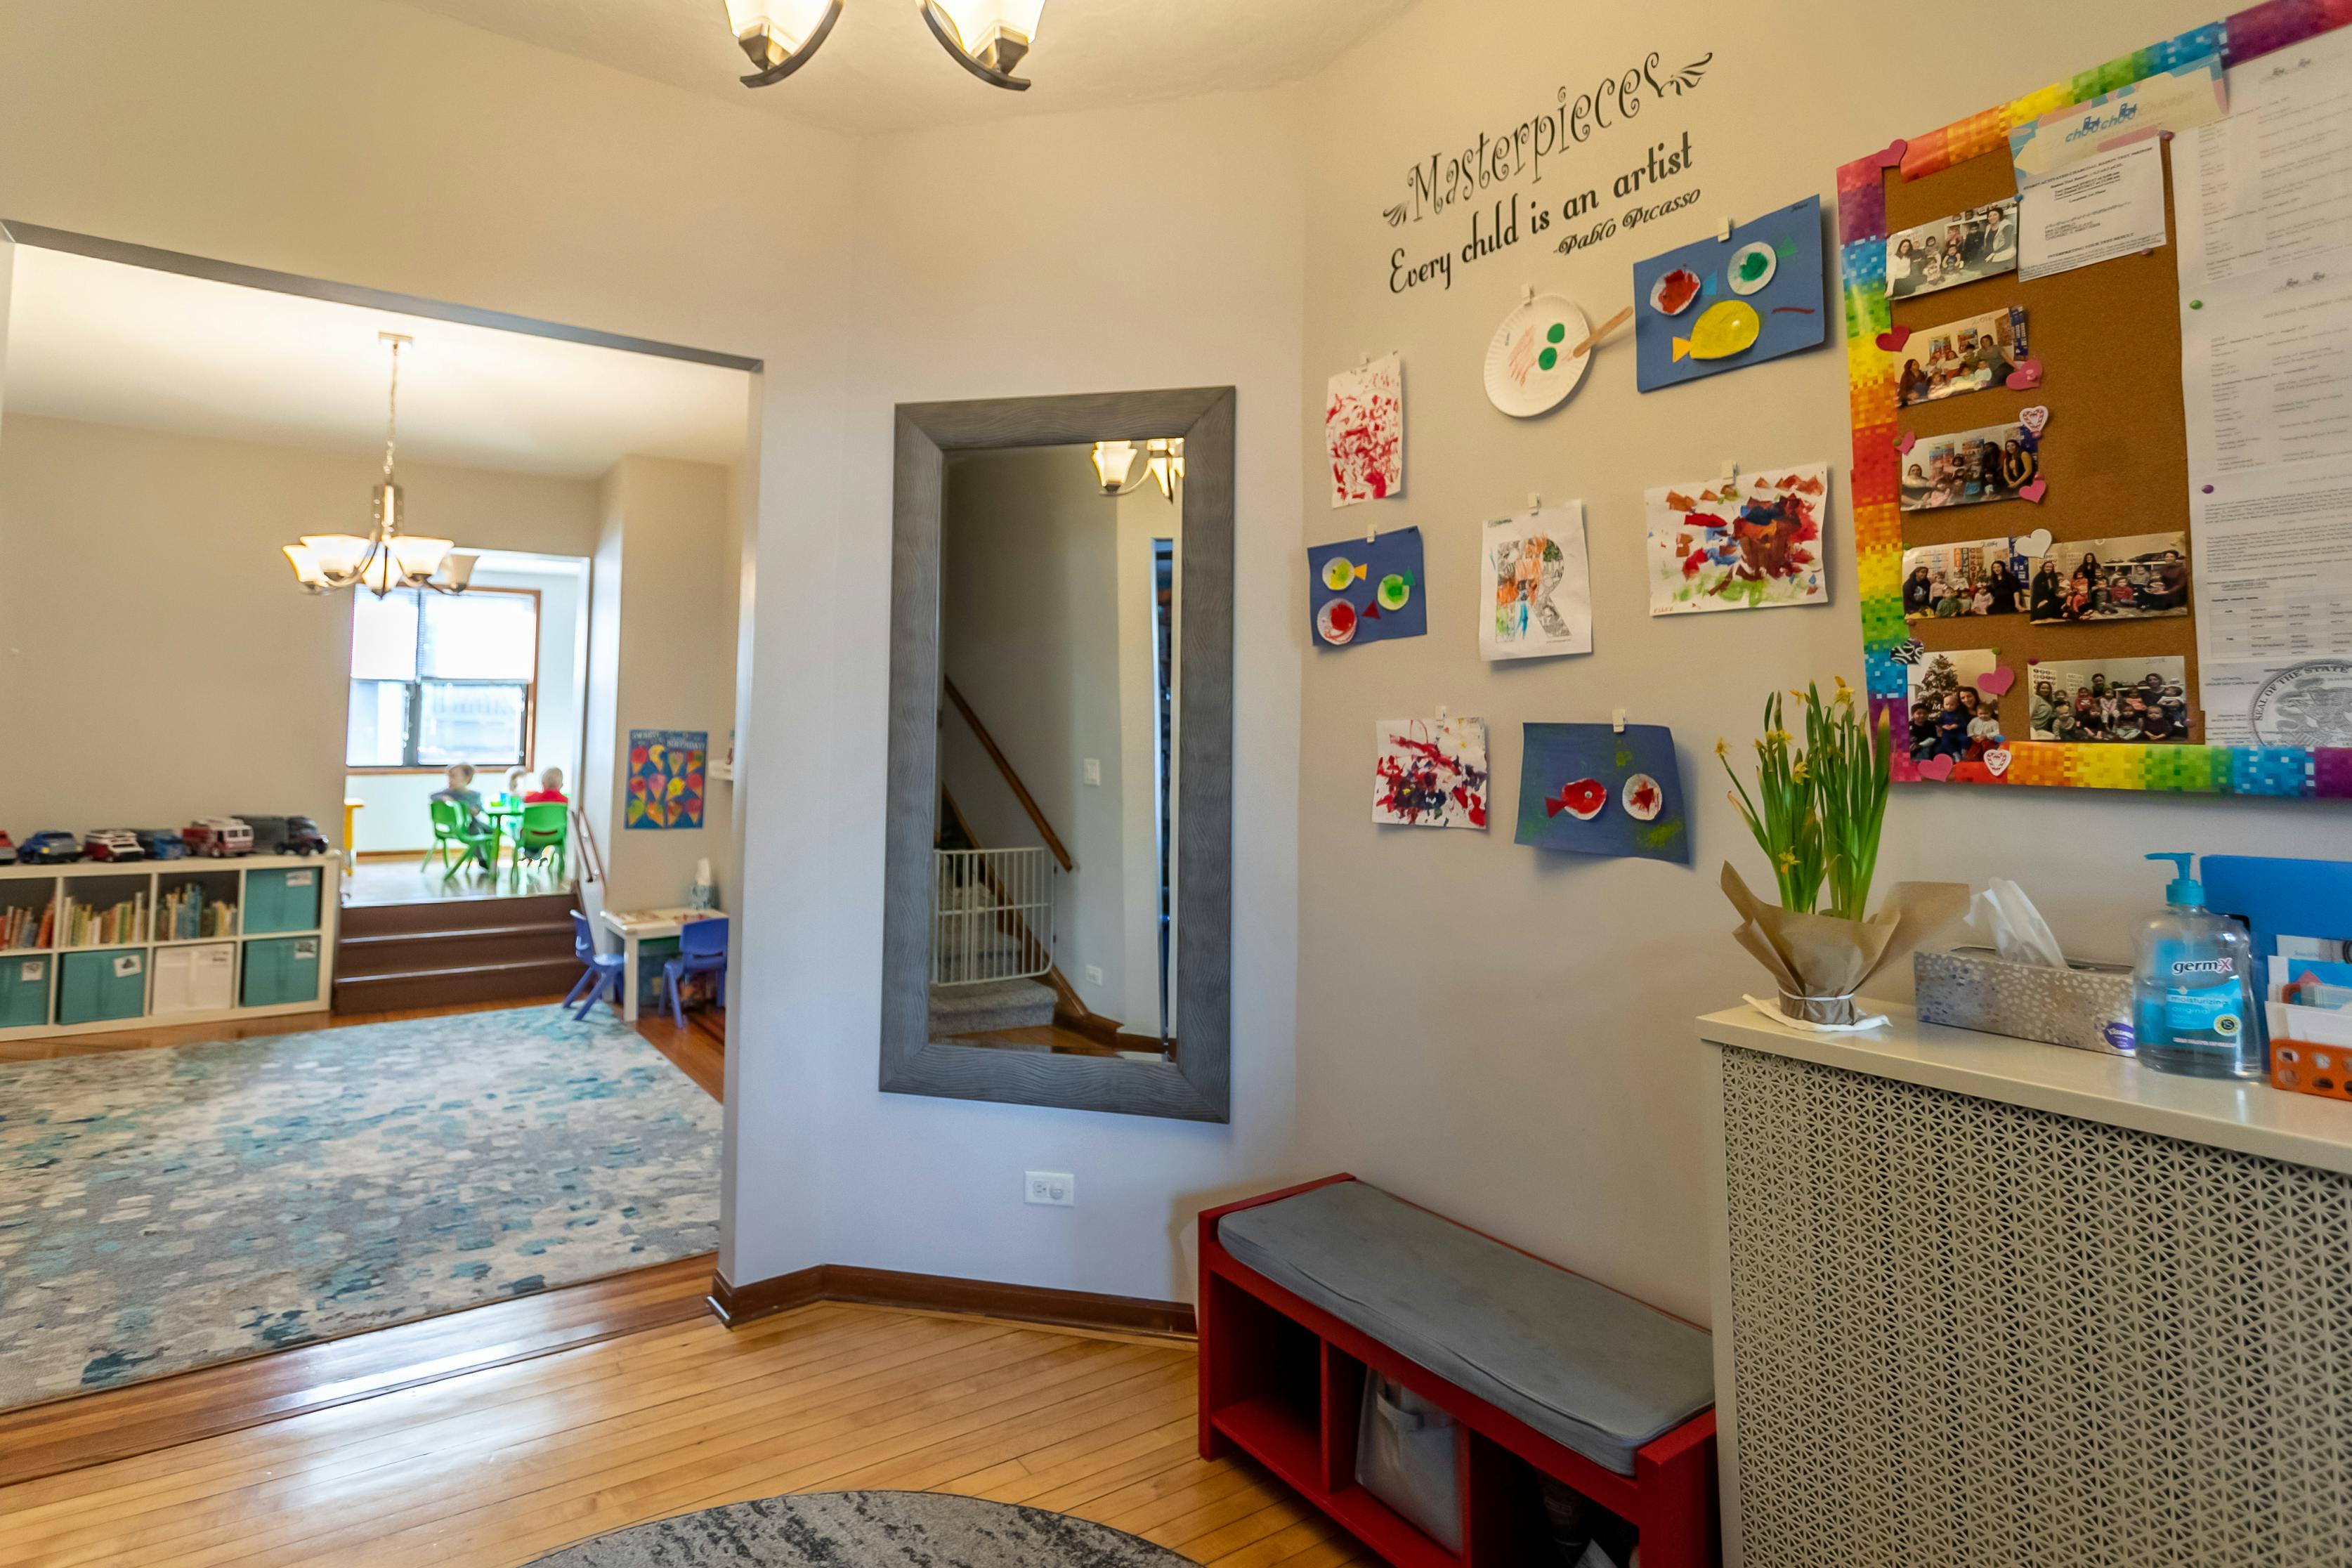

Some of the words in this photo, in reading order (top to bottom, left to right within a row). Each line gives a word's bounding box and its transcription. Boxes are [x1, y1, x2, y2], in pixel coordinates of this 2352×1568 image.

[1407, 51, 1665, 221] Masterpieces
[1389, 247, 1452, 294] Every
[1462, 192, 1519, 263] child
[1531, 201, 1550, 234] is
[1562, 188, 1599, 220] an
[1613, 131, 1692, 199] artist
[1622, 188, 1701, 230] Picasso
[2254, 698, 2268, 721] SEAL
[2265, 684, 2278, 696] OF
[2278, 669, 2303, 685] THE
[2304, 665, 2349, 674] STATE
[2172, 958, 2233, 975] germ-X
[2170, 995, 2228, 1006] moisturizing
